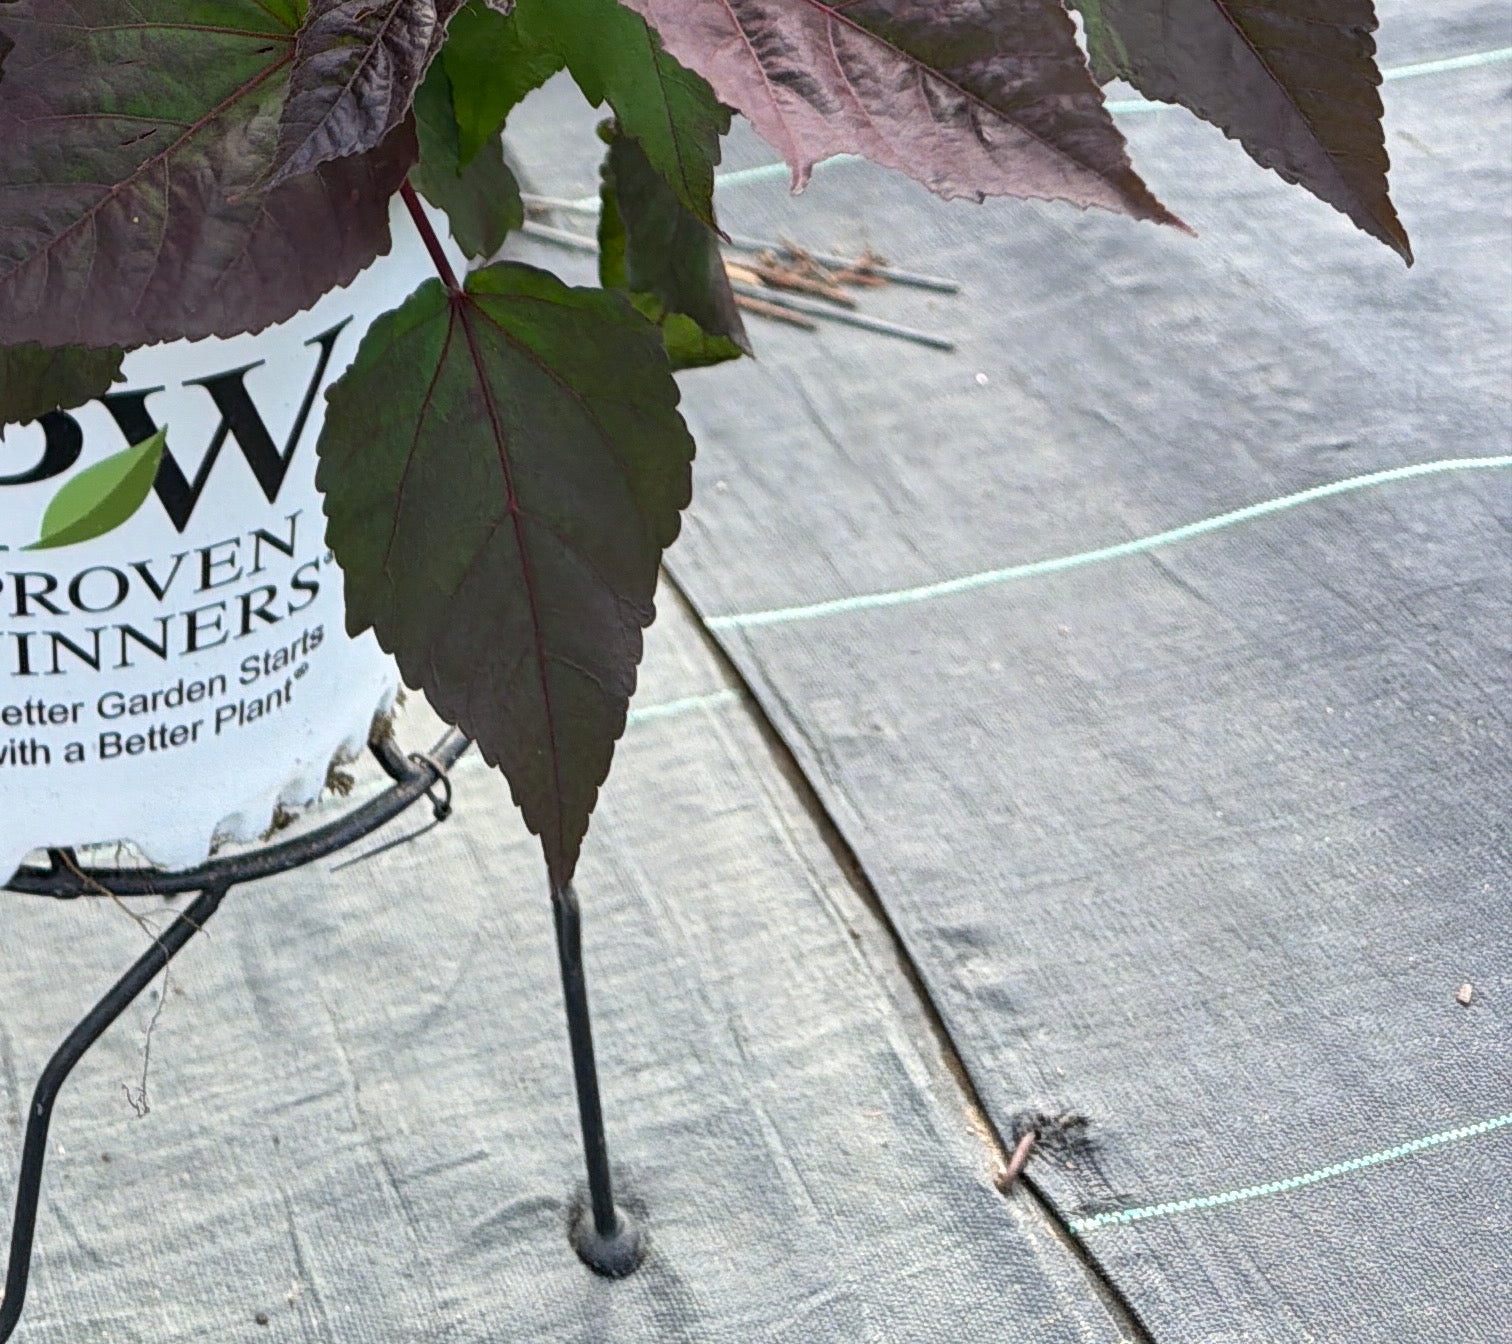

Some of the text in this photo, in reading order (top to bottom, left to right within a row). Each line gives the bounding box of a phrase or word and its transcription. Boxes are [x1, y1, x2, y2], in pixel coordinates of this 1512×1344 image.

[96, 674, 227, 720] Garden
[238, 622, 325, 686] Starts
[64, 741, 86, 763] a
[99, 718, 205, 760] Better
[214, 676, 292, 736] Plant
